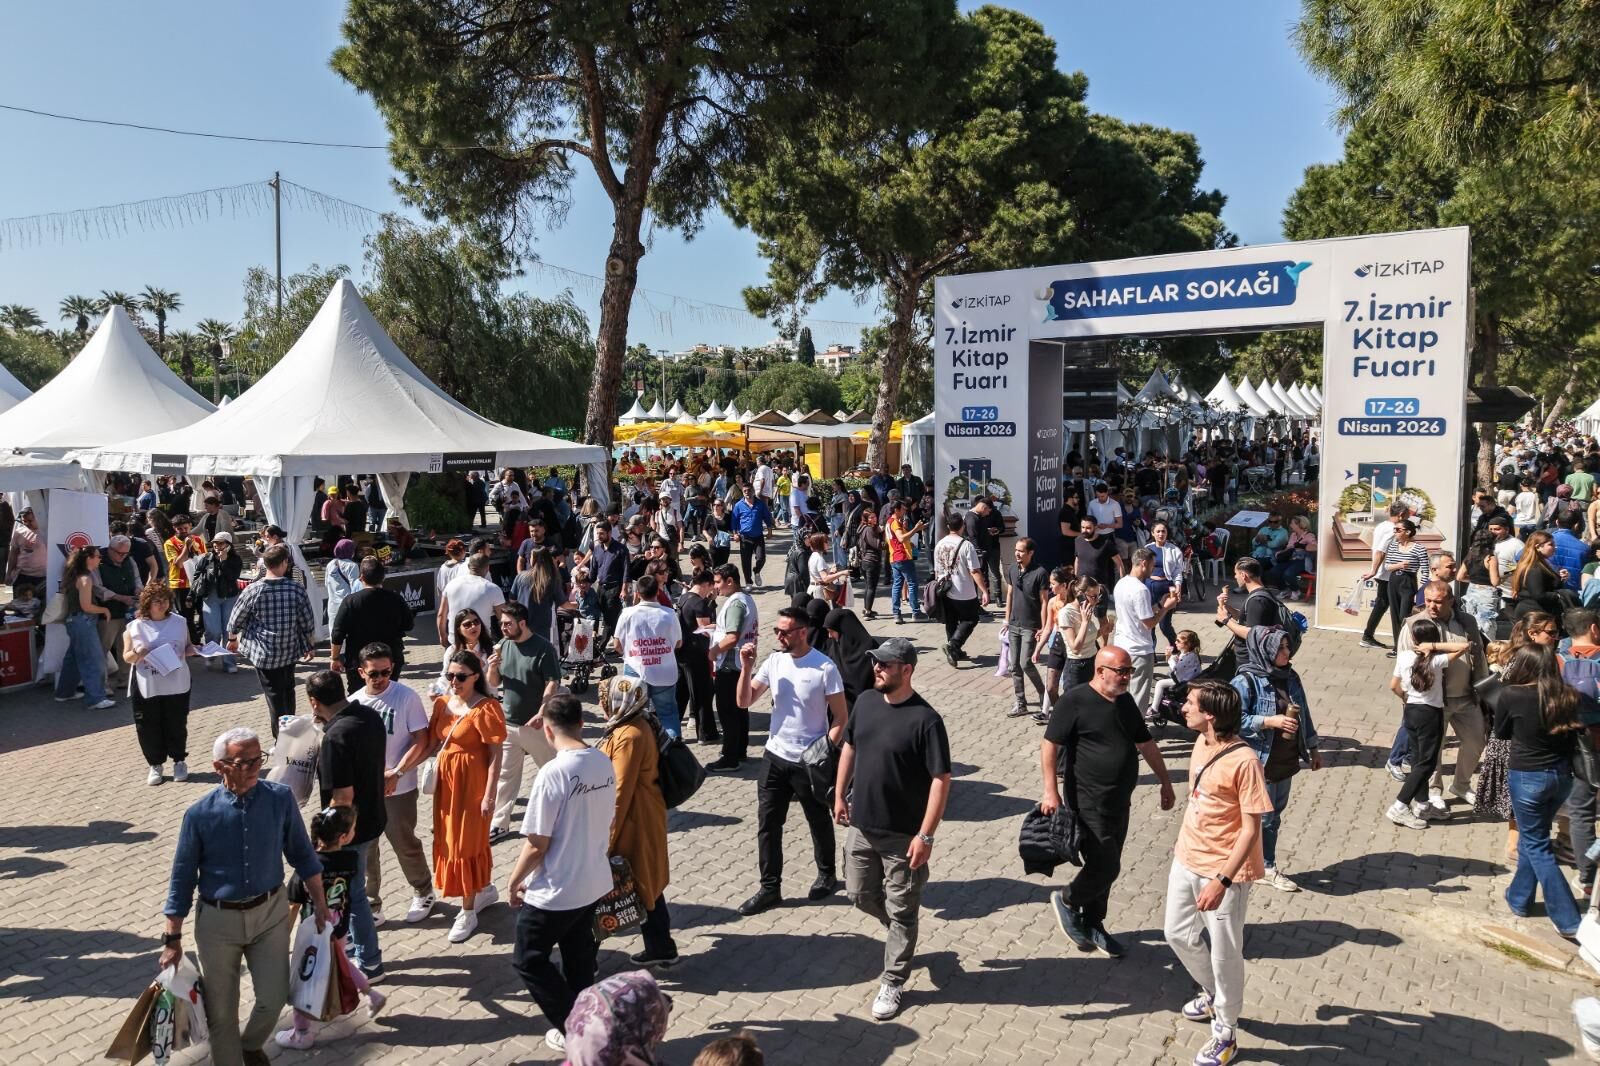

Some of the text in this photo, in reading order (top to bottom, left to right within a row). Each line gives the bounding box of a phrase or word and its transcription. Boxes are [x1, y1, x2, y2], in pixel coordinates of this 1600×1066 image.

[1375, 260, 1444, 278] İZKİTAP
[1064, 270, 1279, 310] SAHAFLAR SOKAĞI
[964, 294, 1011, 309] İZKİTAP
[1344, 292, 1452, 322] 7. İzmir
[945, 321, 1017, 345] 7. İzmir
[1353, 327, 1438, 353] Kitap
[952, 349, 1009, 370] Kitap
[1353, 356, 1435, 378] Fuarı
[953, 373, 1008, 390] Fuarı
[964, 409, 995, 420] 17-26
[1369, 401, 1415, 414] 17-26
[948, 424, 1012, 435] Nisan 2026
[1343, 420, 1440, 433] Nisan 2026
[1033, 450, 1059, 472] 7. İzmir
[1036, 475, 1057, 493] Kitap
[1036, 496, 1056, 513] Fuarı
[615, 905, 637, 919] SIFIR
[618, 911, 640, 926] ATIK
